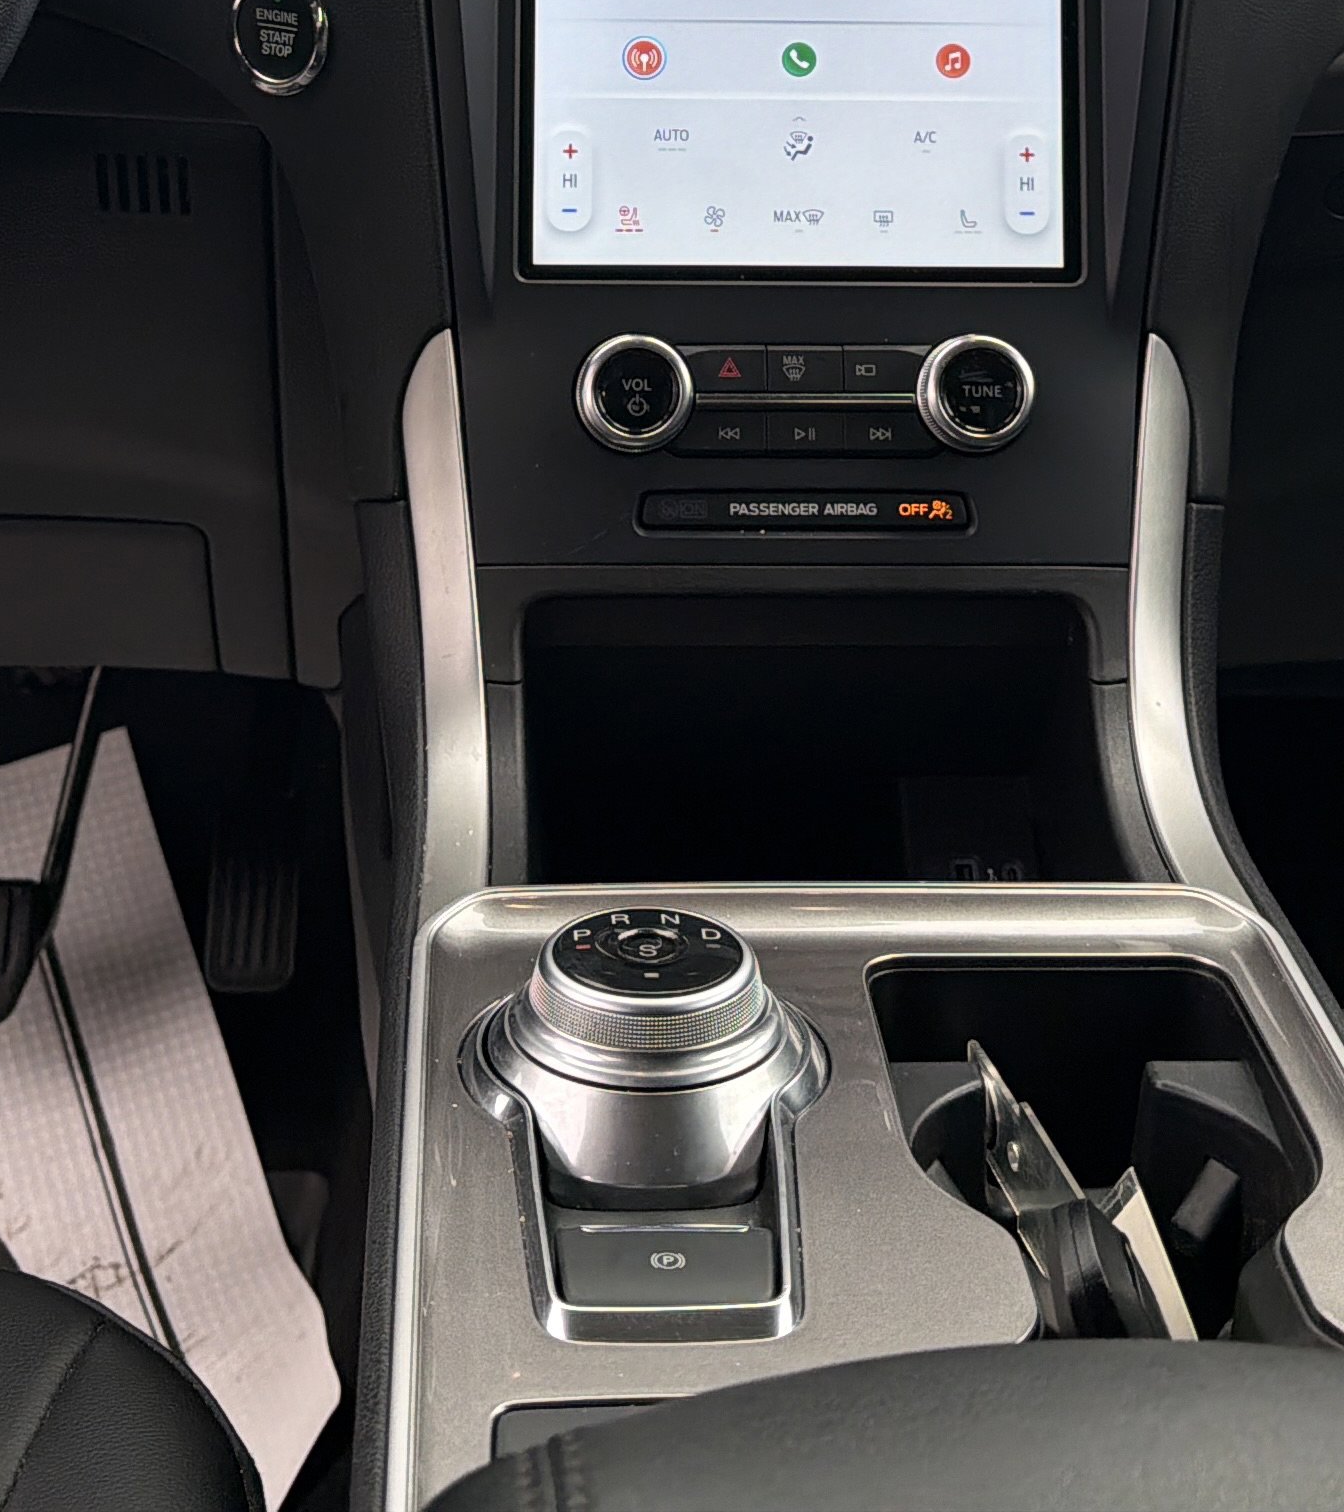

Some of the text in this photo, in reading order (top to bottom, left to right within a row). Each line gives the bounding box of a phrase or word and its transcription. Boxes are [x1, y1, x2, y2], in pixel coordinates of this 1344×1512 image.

[256, 7, 298, 26] ENGINE
[259, 29, 296, 46] START
[261, 42, 292, 58] STOP
[653, 128, 690, 143] AUTO
[913, 129, 937, 145] A/C
[562, 173, 578, 189] HI
[1019, 176, 1035, 192] HI
[773, 209, 801, 224] MAX
[782, 355, 805, 366] MAX
[622, 377, 652, 392] VOL
[962, 384, 1003, 398] TUNE
[729, 502, 878, 517] PASSENGER AIRBAG
[899, 502, 929, 517] OFF
[610, 913, 631, 925] R
[660, 913, 680, 925] N
[573, 929, 592, 941] P
[701, 928, 721, 940] D
[638, 944, 658, 957] S
